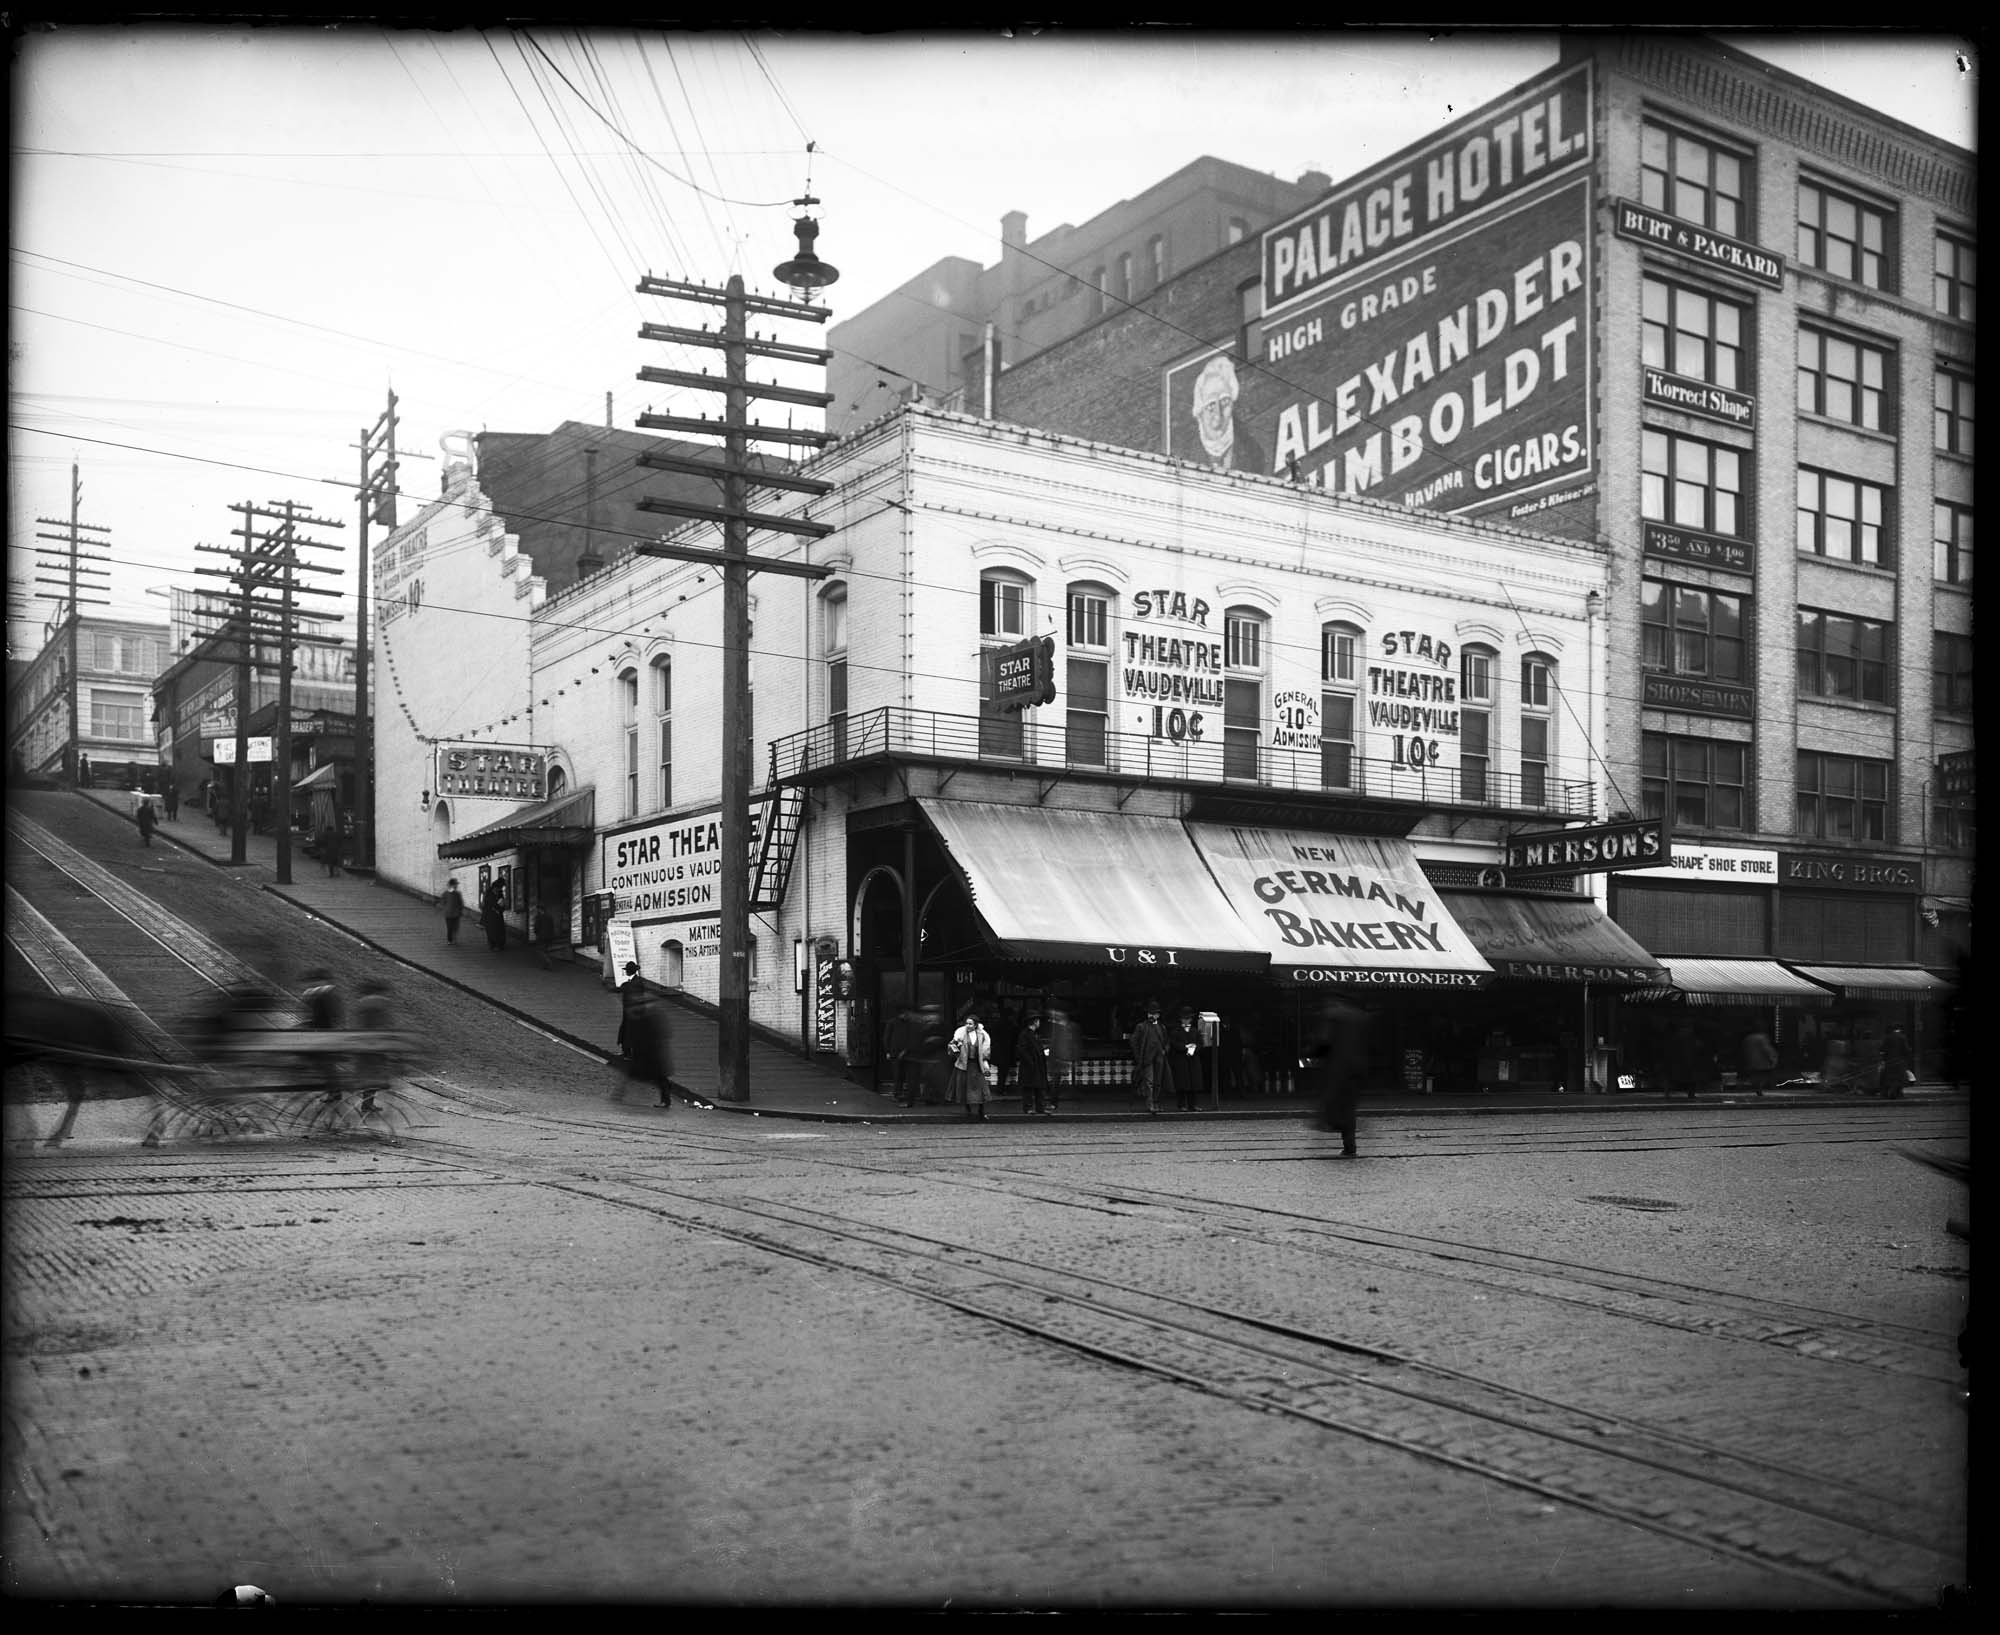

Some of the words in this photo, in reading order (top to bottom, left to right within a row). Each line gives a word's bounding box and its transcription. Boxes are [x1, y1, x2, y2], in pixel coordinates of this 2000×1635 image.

[1273, 172, 1413, 296] PALACE
[1428, 93, 1586, 223] HOTEL.
[1624, 210, 1673, 242] BURT
[1677, 230, 1690, 247] &
[1693, 233, 1780, 279] PACKARD.
[1269, 317, 1323, 362] HIGH
[1340, 265, 1438, 329] GRADE
[1273, 238, 1583, 473] ALEXANDER
[1404, 469, 1464, 507] HAVANA
[1474, 424, 1587, 489] CIGARS.
[1548, 489, 1583, 507] Kleiser
[1686, 542, 1711, 554] AND
[1133, 589, 1211, 629] STAR
[1122, 631, 1223, 672] THEATRE
[1382, 630, 1453, 668] STAR
[999, 657, 1032, 678] STAR
[998, 674, 1033, 694] THEATRE
[1123, 668, 1225, 708] VAUDEVILLE
[1368, 666, 1456, 703] THEATRE
[1647, 682, 1701, 704] SHOES
[1716, 691, 1751, 712] MEN
[1274, 691, 1319, 719] GENERAL
[1368, 701, 1459, 736] VAUDEVILLE
[1272, 727, 1322, 750] ADMISSION
[447, 751, 537, 774] STAR
[443, 774, 544, 798] THEATRE
[617, 834, 661, 868] STAR
[1292, 845, 1337, 864] NEW
[1508, 826, 1660, 868] EMERSON'S
[611, 865, 684, 890] CONTINUOUS
[1709, 857, 1736, 872] SHOE
[1740, 859, 1776, 875] STORE.
[1788, 859, 1847, 881] KING
[1853, 864, 1915, 885] BROS.
[634, 884, 712, 913] ADMISSION
[1253, 869, 1426, 921] GERMAN
[1263, 908, 1448, 953] BAKERY
[684, 946, 697, 958] THIS
[1108, 947, 1127, 964] U
[1137, 948, 1157, 964] &
[1168, 951, 1179, 966] I
[1292, 968, 1482, 987] CONFECTIONERY
